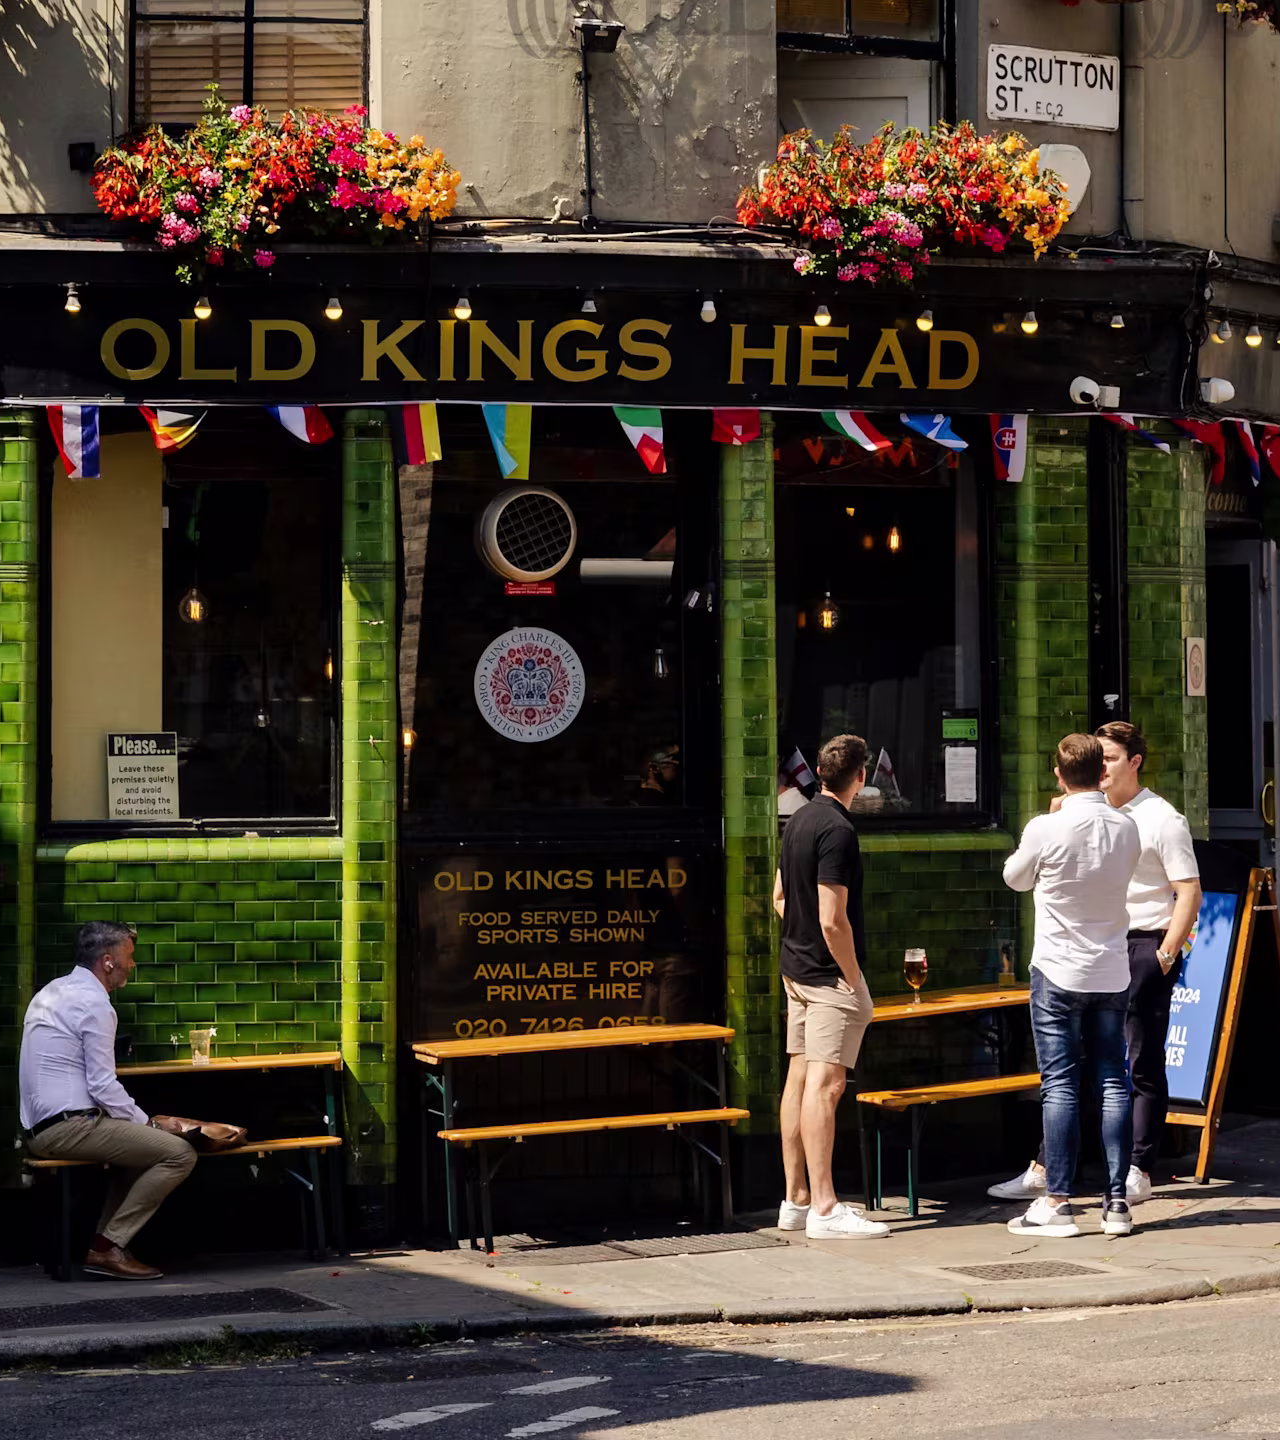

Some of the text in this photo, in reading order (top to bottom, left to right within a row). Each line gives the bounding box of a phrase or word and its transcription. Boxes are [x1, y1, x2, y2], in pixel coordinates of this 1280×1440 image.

[995, 53, 1114, 91] SCRUTTON
[100, 317, 980, 391] OLD KINGS HEAD
[485, 632, 574, 665] KING CHARLES III
[479, 674, 525, 737] CORONATION
[536, 673, 581, 737] 6TH MAY 2023
[112, 776, 174, 784] premises quietly
[141, 786, 161, 794] avoid
[117, 797, 156, 805] disturbing
[433, 868, 688, 892] OLD KINGS HEAD
[459, 910, 660, 927] FOOD SERVED DAILY
[477, 927, 645, 945] SPORTS SHOWN
[474, 961, 654, 980] AVAILABLE FOR
[487, 983, 642, 1002] PRIVATE HIRE
[1171, 986, 1200, 1003] 2024
[1169, 1004, 1182, 1013] NY
[455, 1018, 507, 1038] 020
[520, 1017, 584, 1035] 7426
[1168, 1025, 1187, 1045] ALL
